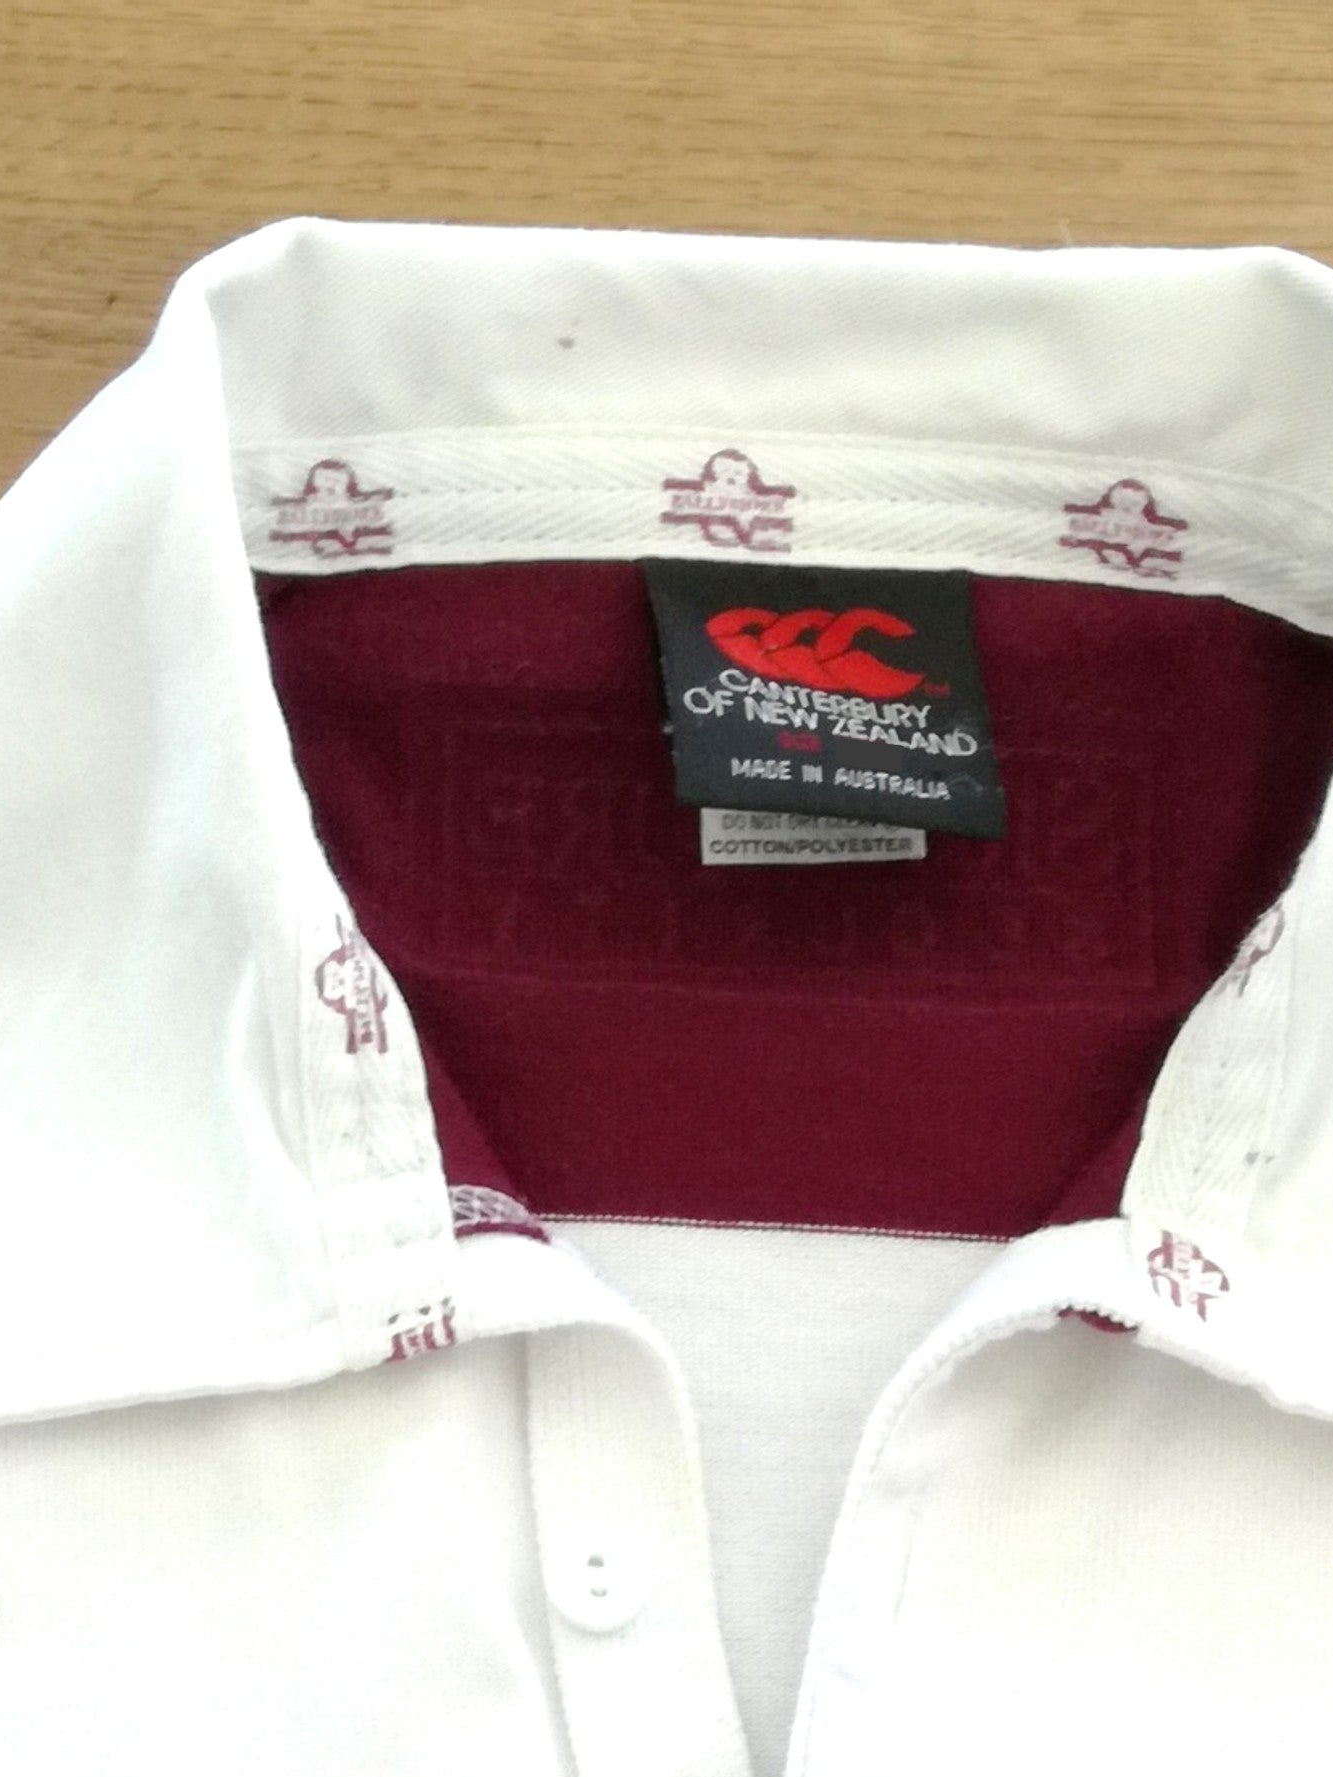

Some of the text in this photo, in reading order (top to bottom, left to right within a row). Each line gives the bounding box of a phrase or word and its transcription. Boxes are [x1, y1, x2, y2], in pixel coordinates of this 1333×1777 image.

[683, 686, 734, 716] OF
[744, 696, 818, 730] NEW
[827, 714, 979, 756] ZEALAND
[719, 668, 931, 729] CANTERBURY
[731, 757, 951, 800] MADE IN AUSTRALIA
